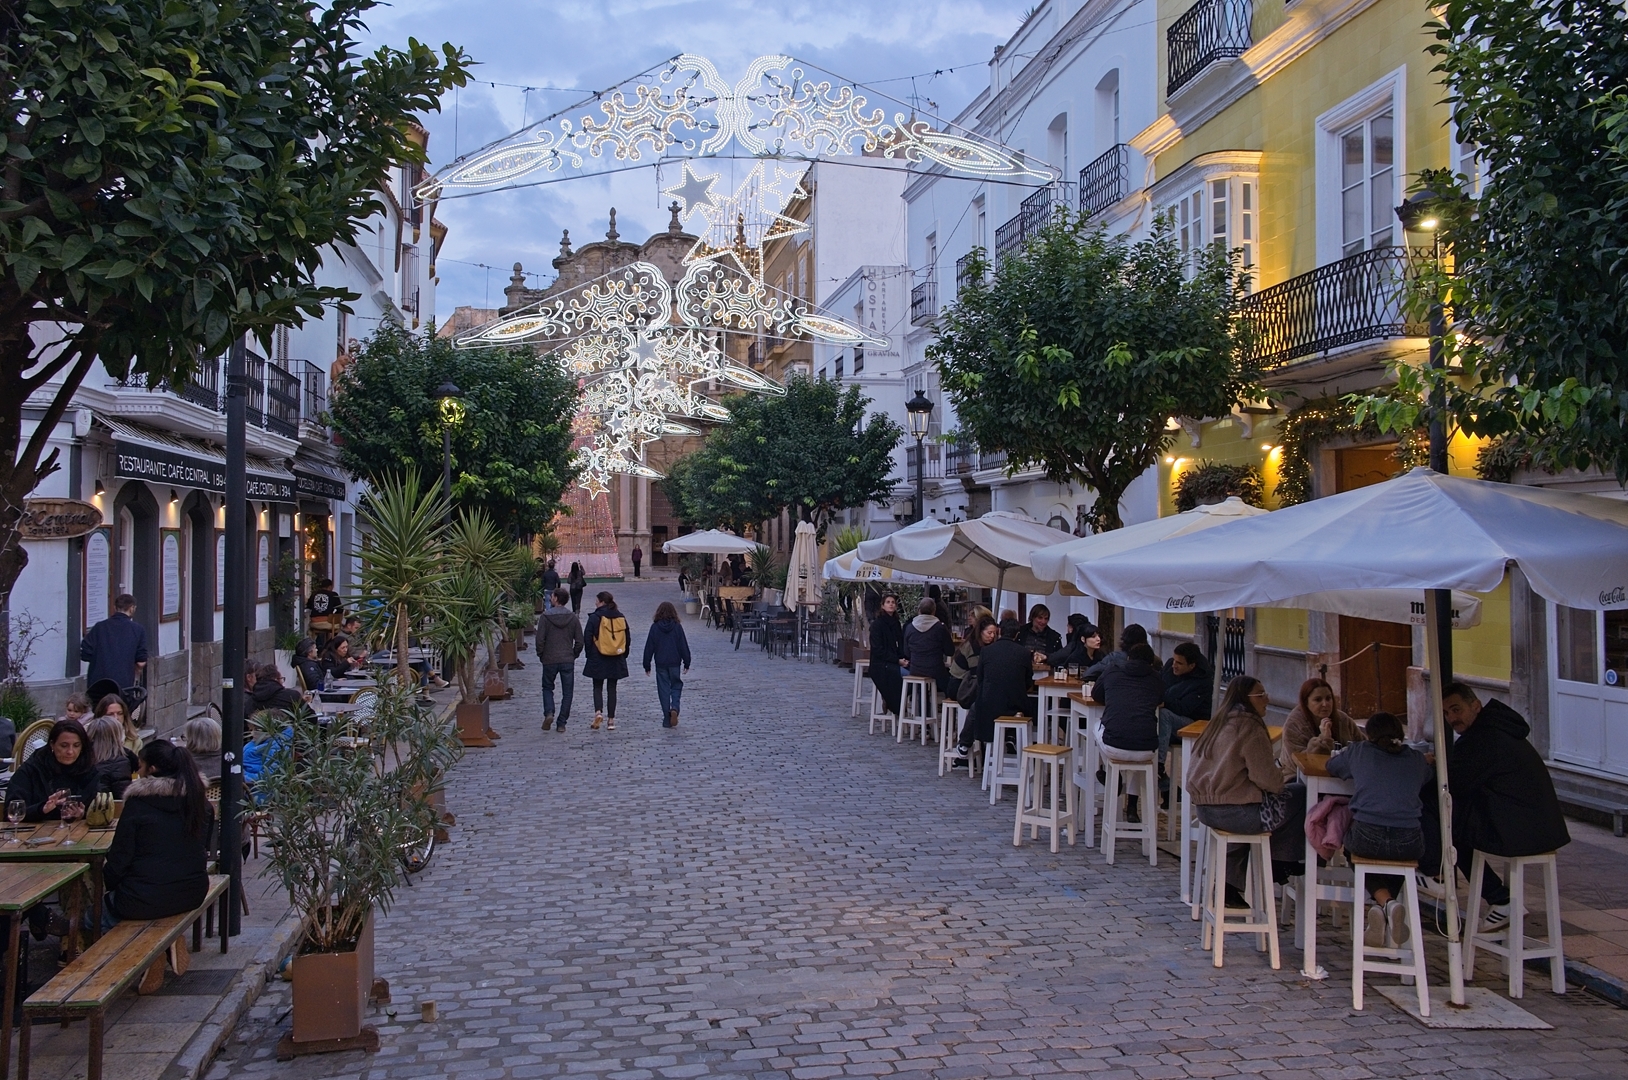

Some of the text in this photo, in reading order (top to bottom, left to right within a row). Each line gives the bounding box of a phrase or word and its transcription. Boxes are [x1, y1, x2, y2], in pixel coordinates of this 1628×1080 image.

[119, 454, 167, 477] RESTAURANTE
[167, 461, 184, 480] CAFÉ
[184, 467, 210, 484] CENTRAL
[246, 476, 259, 495] CAFÉ
[259, 482, 279, 496] CENTRAL
[35, 510, 98, 527] Central
[855, 570, 882, 578] BLISS
